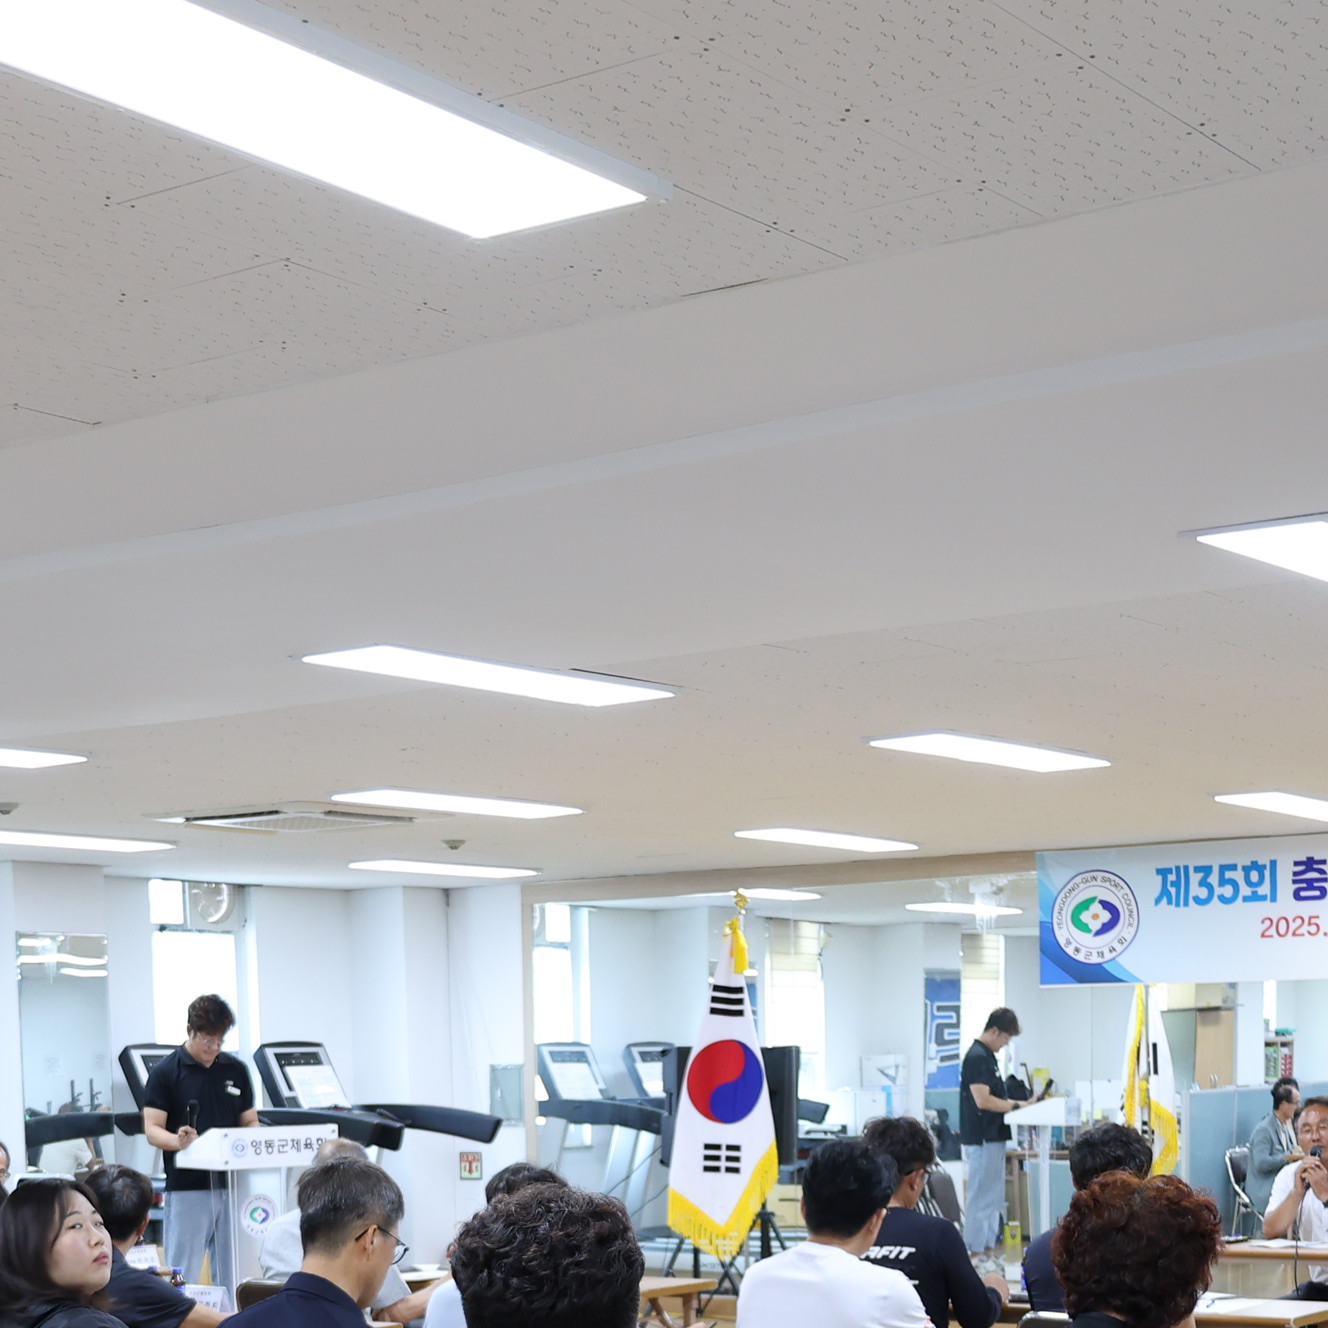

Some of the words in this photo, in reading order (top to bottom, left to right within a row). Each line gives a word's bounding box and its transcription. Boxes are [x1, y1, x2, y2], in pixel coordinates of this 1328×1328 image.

[1154, 859, 1279, 908] 제35회
[1100, 876, 1124, 893] SPORT
[1121, 893, 1136, 930] COUNCIL
[1260, 915, 1328, 939] 2025.
[250, 1137, 328, 1156] 영동군체육회
